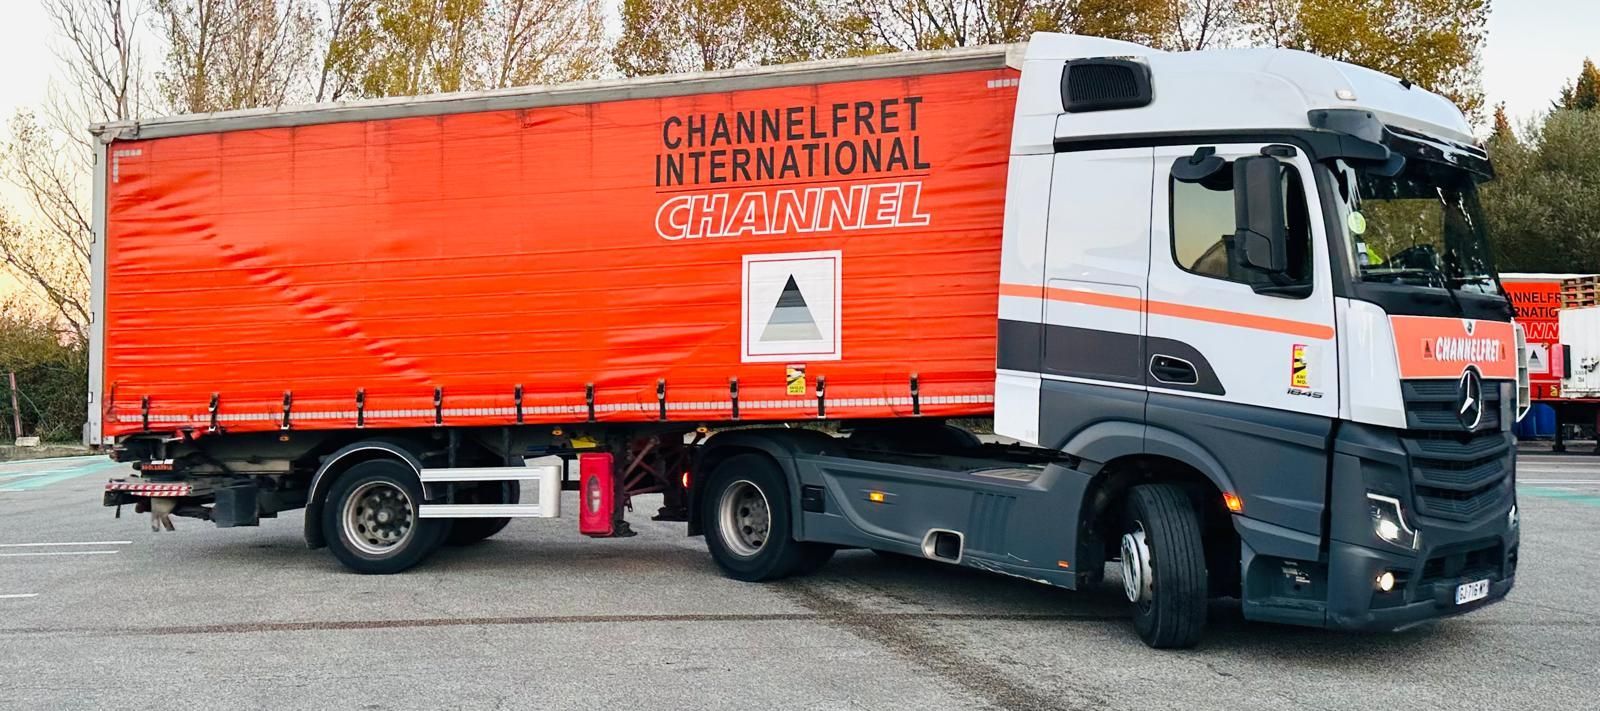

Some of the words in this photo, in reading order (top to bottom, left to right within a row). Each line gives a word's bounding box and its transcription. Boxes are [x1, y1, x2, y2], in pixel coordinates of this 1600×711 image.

[663, 96, 923, 149] CHANNELFRET
[655, 136, 931, 187] INTERNATIONAL
[655, 181, 931, 241] CHANNEL
[1434, 336, 1500, 362] CHANNELFRET
[1287, 388, 1325, 398] 1845
